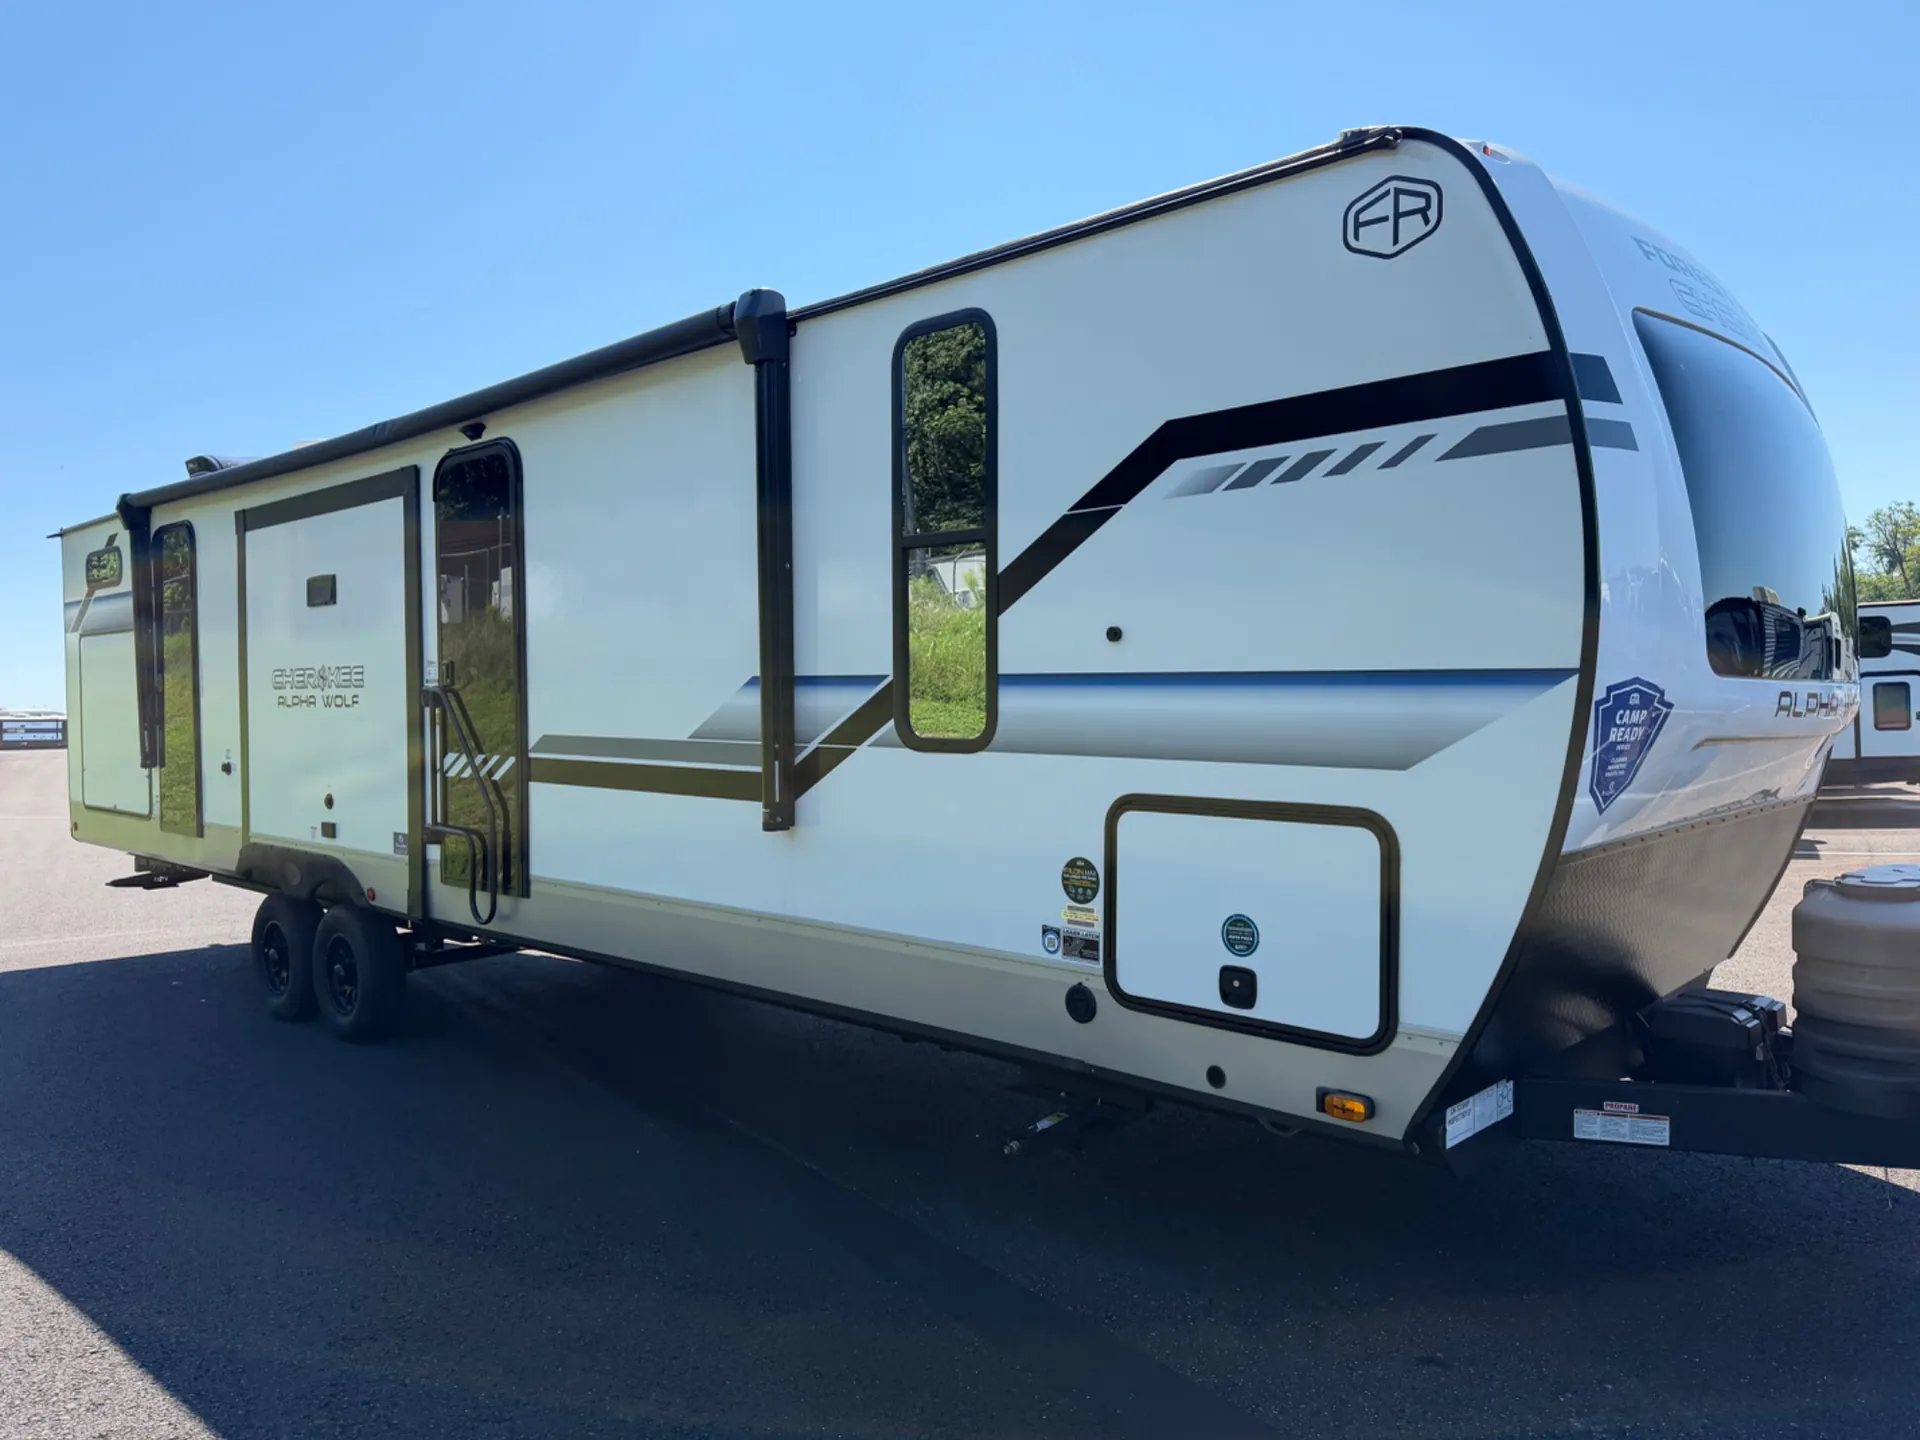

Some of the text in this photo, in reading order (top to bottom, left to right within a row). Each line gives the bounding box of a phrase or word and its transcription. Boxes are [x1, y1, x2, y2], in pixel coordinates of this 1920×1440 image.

[272, 664, 365, 692] CHEROKEE
[277, 694, 359, 708] ALPHA WOLF
[1774, 690, 1839, 718] ALPHA
[1615, 709, 1648, 725] CAMP
[1609, 727, 1646, 742] READY
